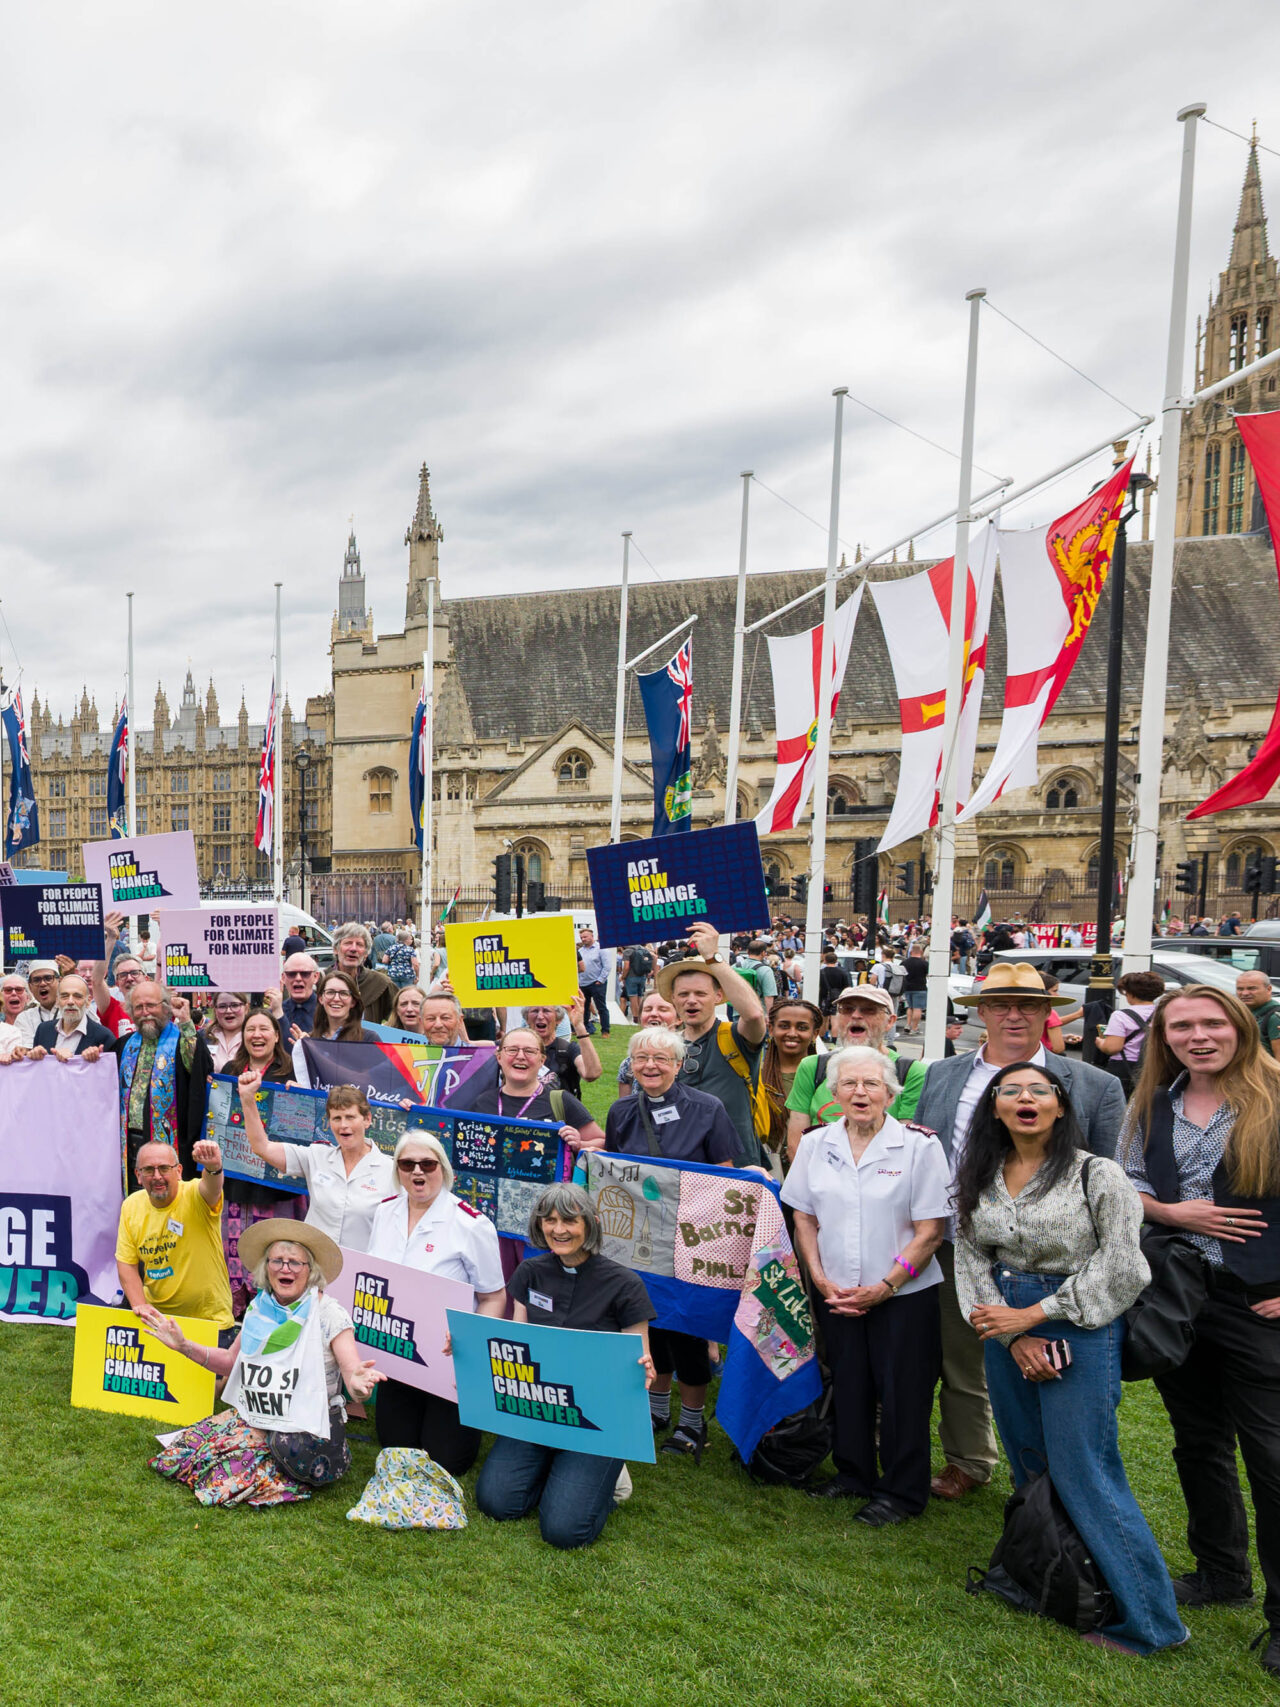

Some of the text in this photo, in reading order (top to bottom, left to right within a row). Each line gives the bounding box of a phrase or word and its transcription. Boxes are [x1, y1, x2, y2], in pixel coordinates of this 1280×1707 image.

[110, 854, 131, 866] ACT
[628, 858, 658, 878] ACT
[111, 864, 136, 877] NOW
[112, 874, 155, 890] CHANGE
[628, 872, 668, 892] NOW
[43, 888, 98, 900] FOR PEOPLE
[113, 885, 162, 901] FOREVER
[631, 884, 697, 907] CHANGE
[38, 900, 99, 913] FOR CLIMATE
[632, 898, 707, 922] FOREVER
[43, 913, 100, 925] FOR NATURE
[210, 915, 274, 927] FOR PEOPLE
[204, 929, 274, 941] FOR CLIMATE
[167, 946, 185, 956] ACT
[209, 943, 274, 955] FOR NATURE
[474, 937, 500, 951] ACT
[167, 956, 188, 966] NOW
[475, 950, 505, 963] NOW
[167, 966, 204, 976] CHANGE
[476, 962, 526, 976] CHANGE
[167, 975, 208, 986] FOREVER
[477, 974, 533, 990] FOREVER
[366, 1085, 400, 1101] Peace
[224, 1150, 266, 1168] CLAYGATE
[724, 1189, 757, 1216] St
[356, 1275, 384, 1297] ACT
[354, 1290, 388, 1315] NOW
[352, 1306, 409, 1340] CHANGE
[107, 1328, 135, 1345] ACT
[106, 1344, 139, 1363] NOW
[490, 1341, 524, 1363] ACT
[105, 1359, 160, 1382] CHANGE
[491, 1358, 534, 1383] NOW
[104, 1376, 165, 1399] FOREVER
[494, 1375, 568, 1407] CHANGE
[496, 1392, 580, 1426] FOREVER
